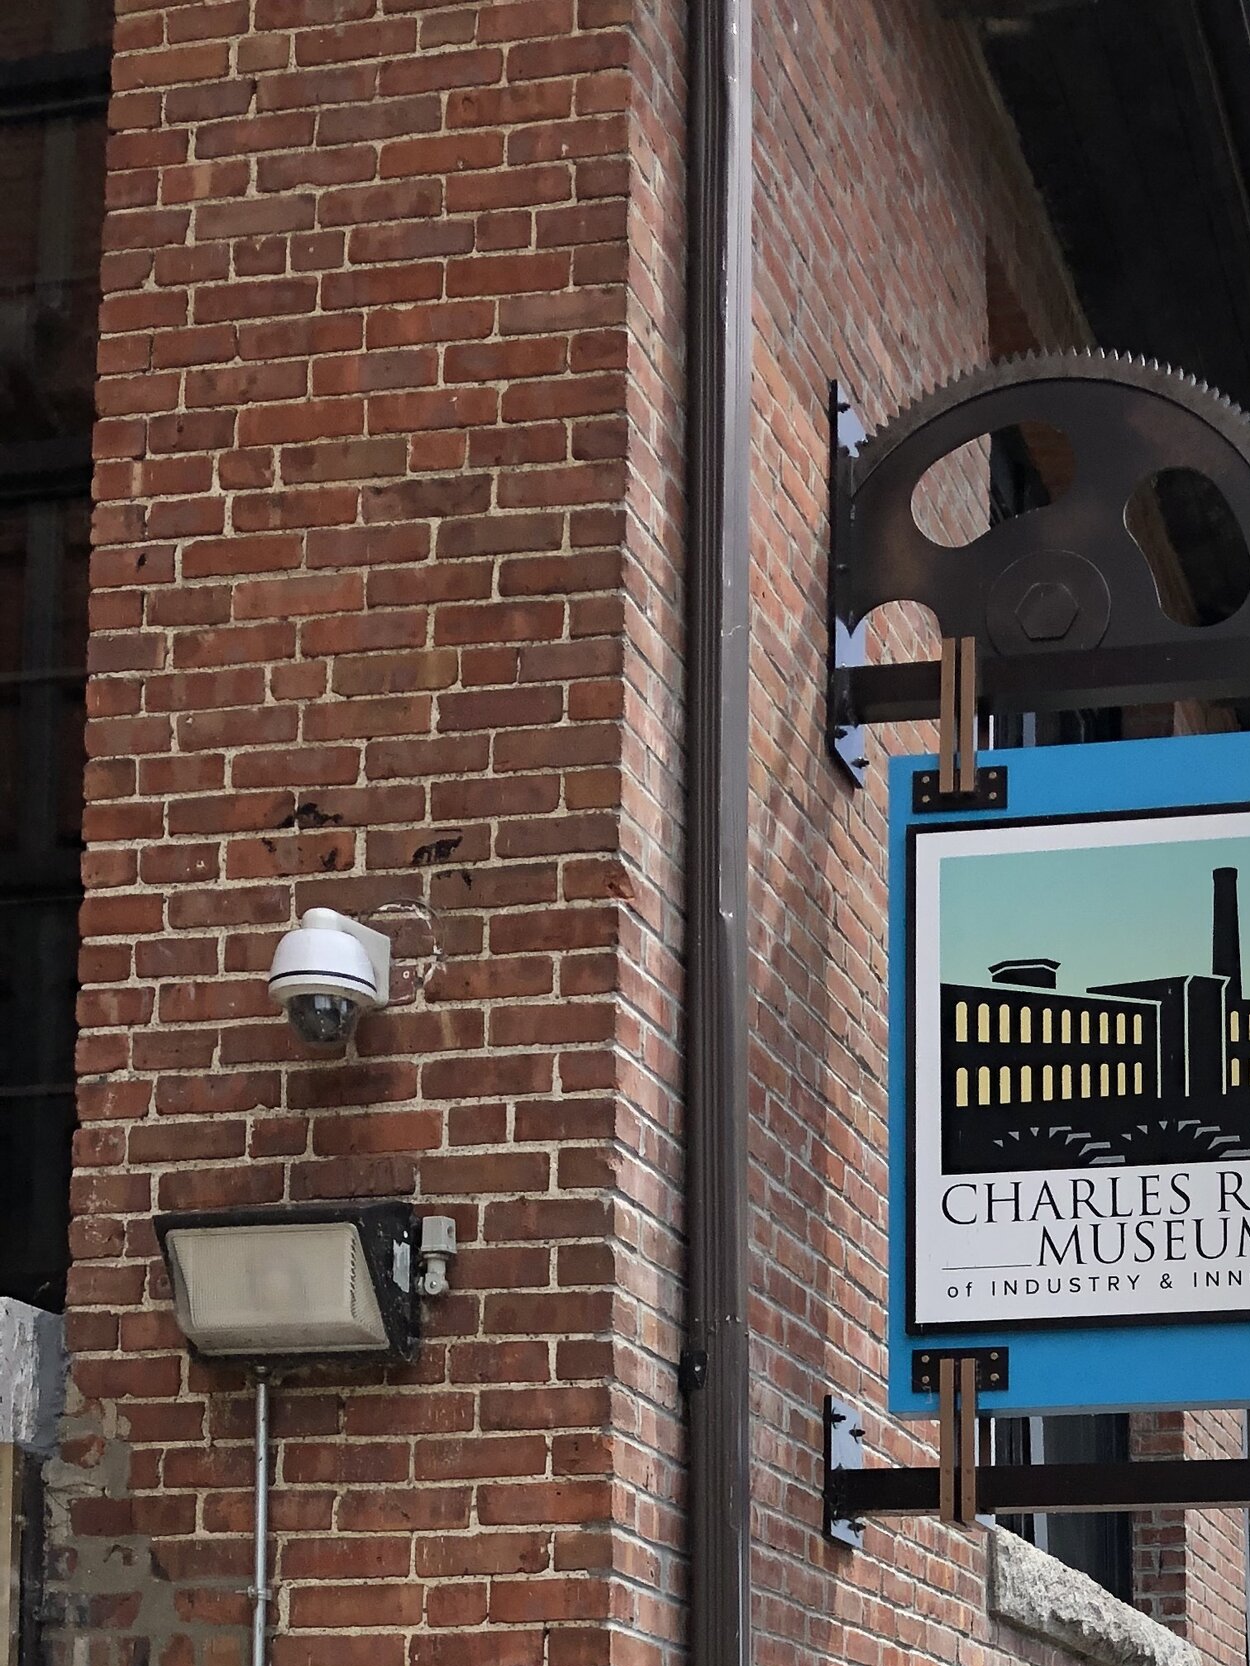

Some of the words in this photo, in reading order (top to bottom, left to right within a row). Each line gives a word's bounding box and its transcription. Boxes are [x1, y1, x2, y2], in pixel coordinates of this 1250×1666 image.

[941, 1172, 1191, 1225] CHARLES
[947, 1281, 973, 1299] of
[991, 1272, 1141, 1297] INDUSTRY
[1159, 1272, 1173, 1290] &
